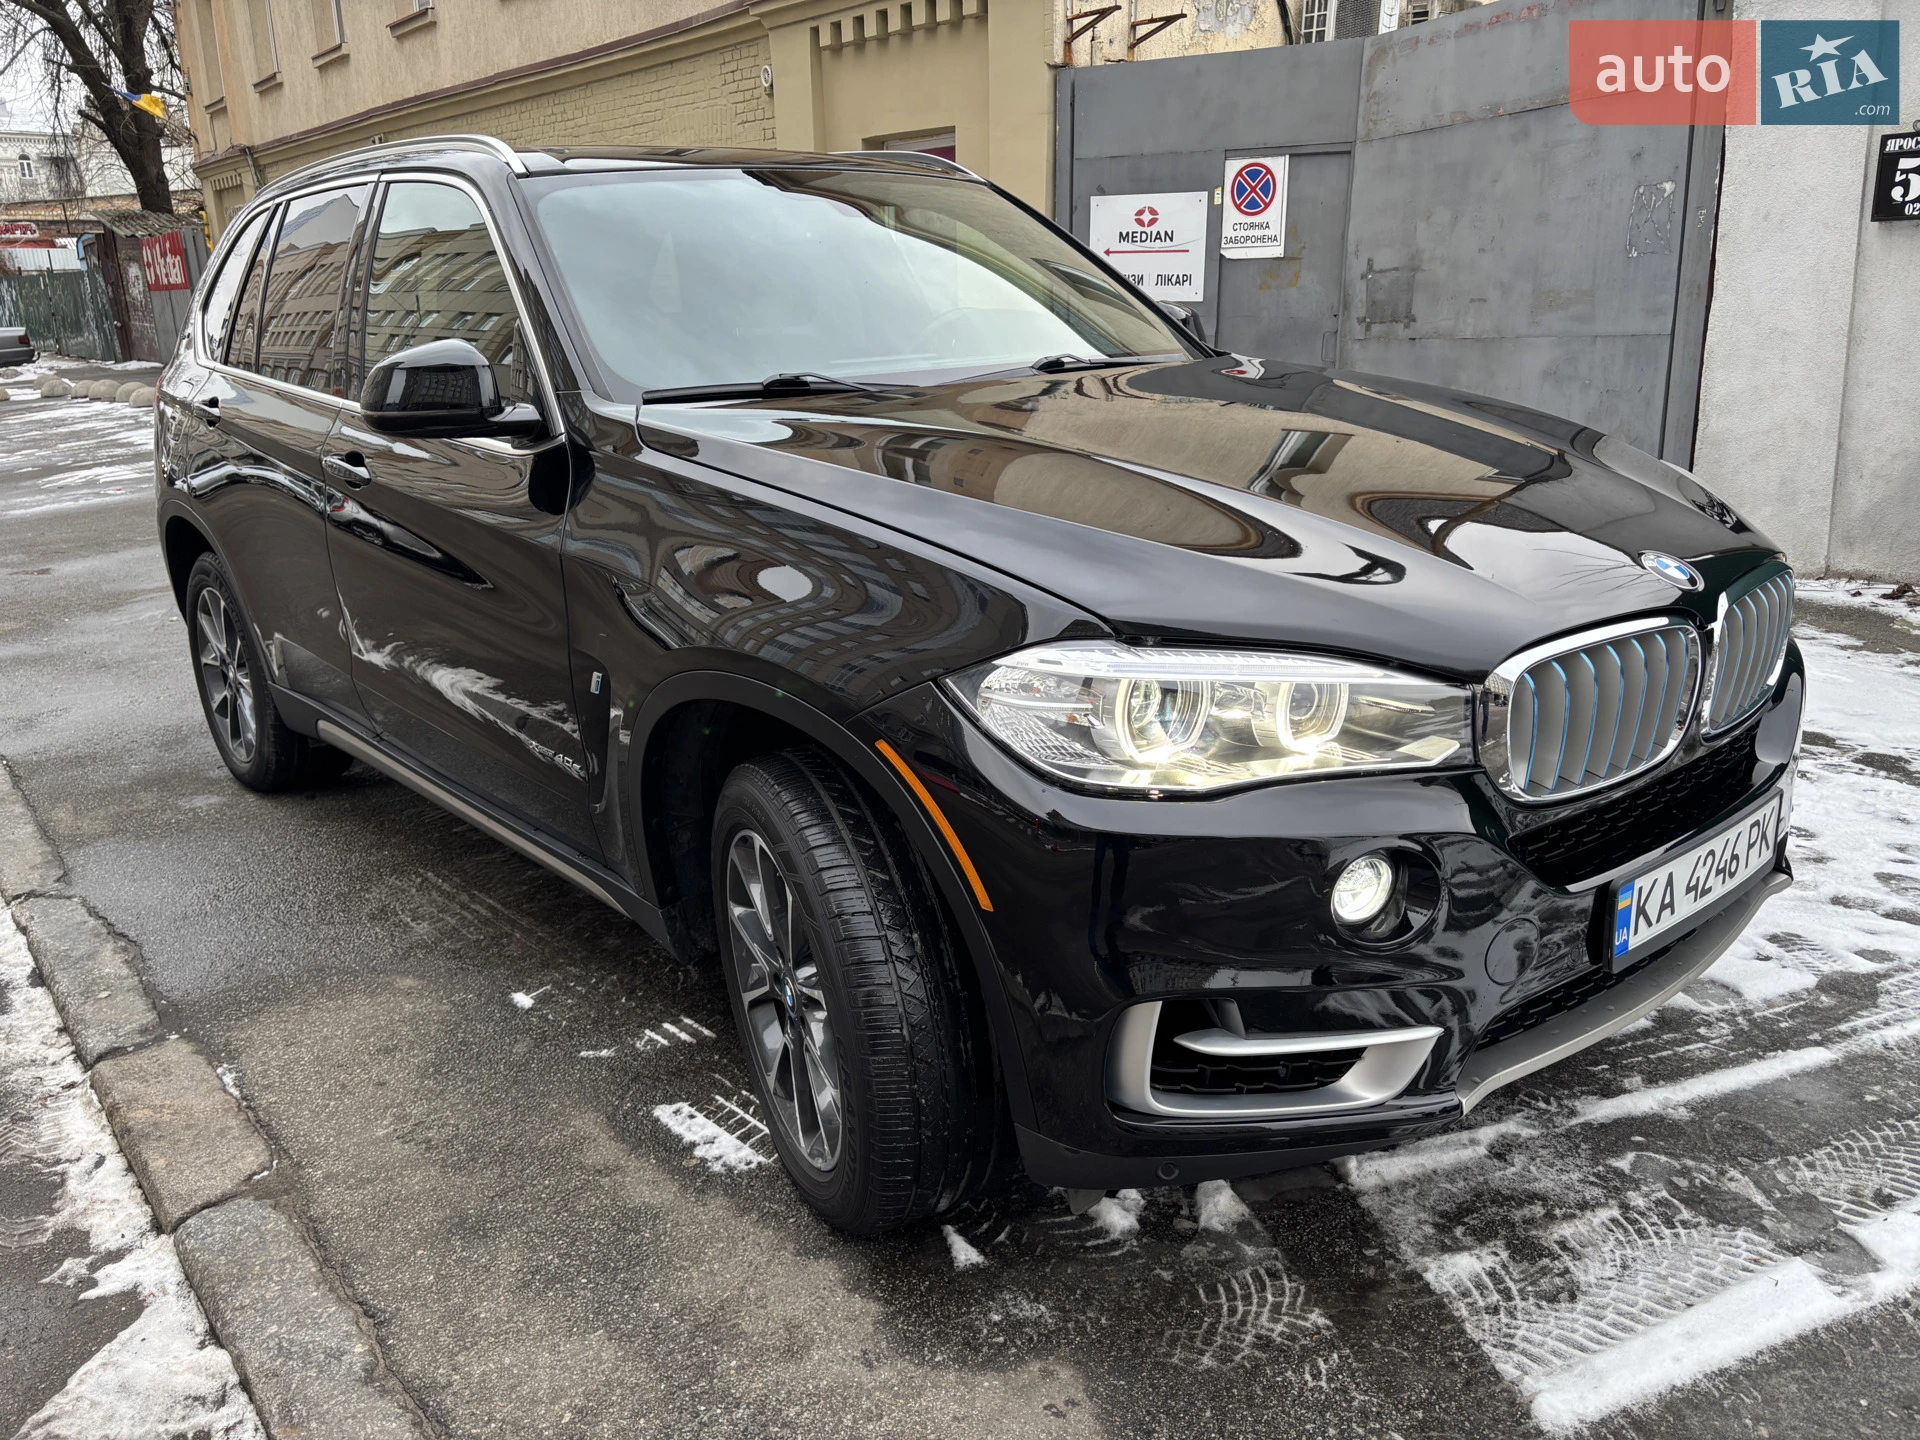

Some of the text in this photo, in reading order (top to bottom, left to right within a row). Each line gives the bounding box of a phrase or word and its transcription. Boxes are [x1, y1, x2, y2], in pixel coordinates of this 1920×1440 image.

[1885, 137, 1920, 152] ЯРОС
[1232, 221, 1271, 232] СТОЯНКА
[1118, 230, 1174, 244] MEDIAN
[1223, 234, 1279, 245] ЗАБОРОНЕНА
[1155, 273, 1192, 287] ЛІКАРІ
[1633, 805, 1776, 936] KA 4246 PK
[1615, 927, 1628, 945] UA
